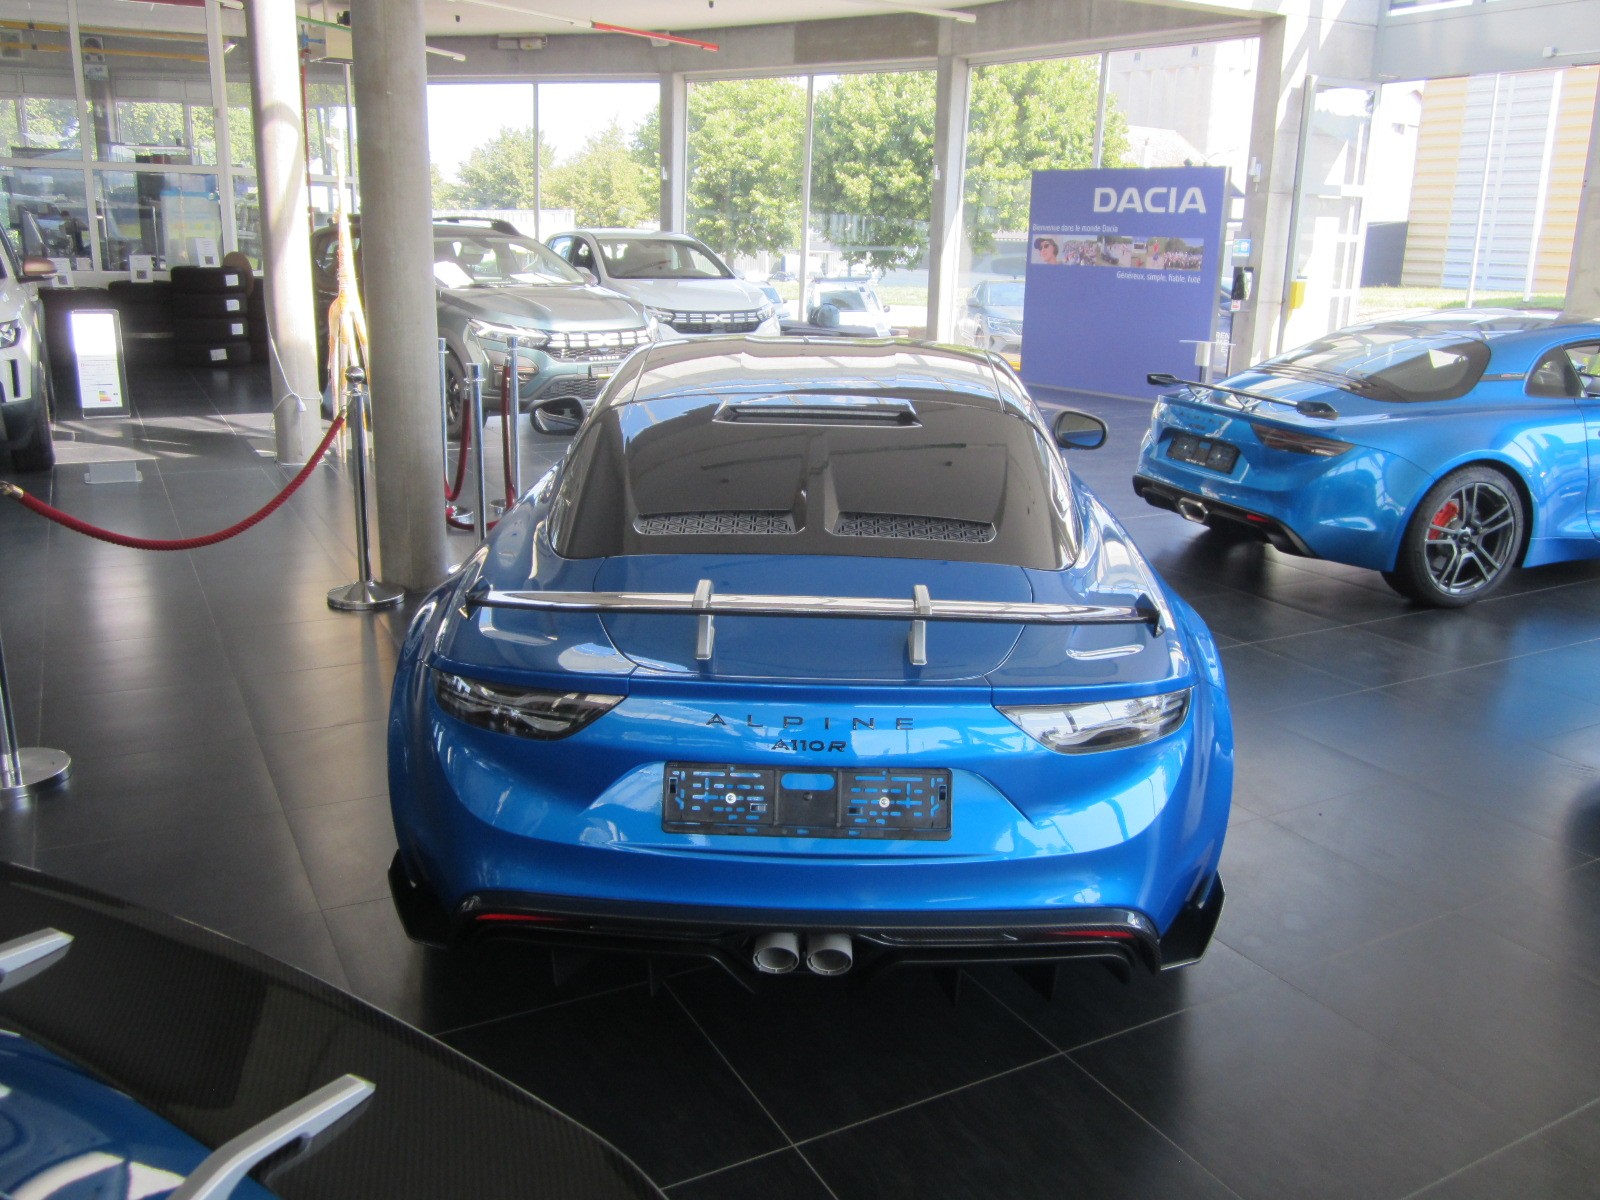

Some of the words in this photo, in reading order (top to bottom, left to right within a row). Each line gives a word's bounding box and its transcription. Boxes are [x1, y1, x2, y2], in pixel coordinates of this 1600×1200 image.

[1093, 187, 1207, 213] DACIA
[1032, 223, 1061, 232] Bienvenue
[1061, 224, 1075, 232] dans
[1081, 224, 1101, 232] monde
[1102, 224, 1119, 233] Dacia
[706, 713, 914, 731] ALPINE
[771, 739, 847, 753] A110R
